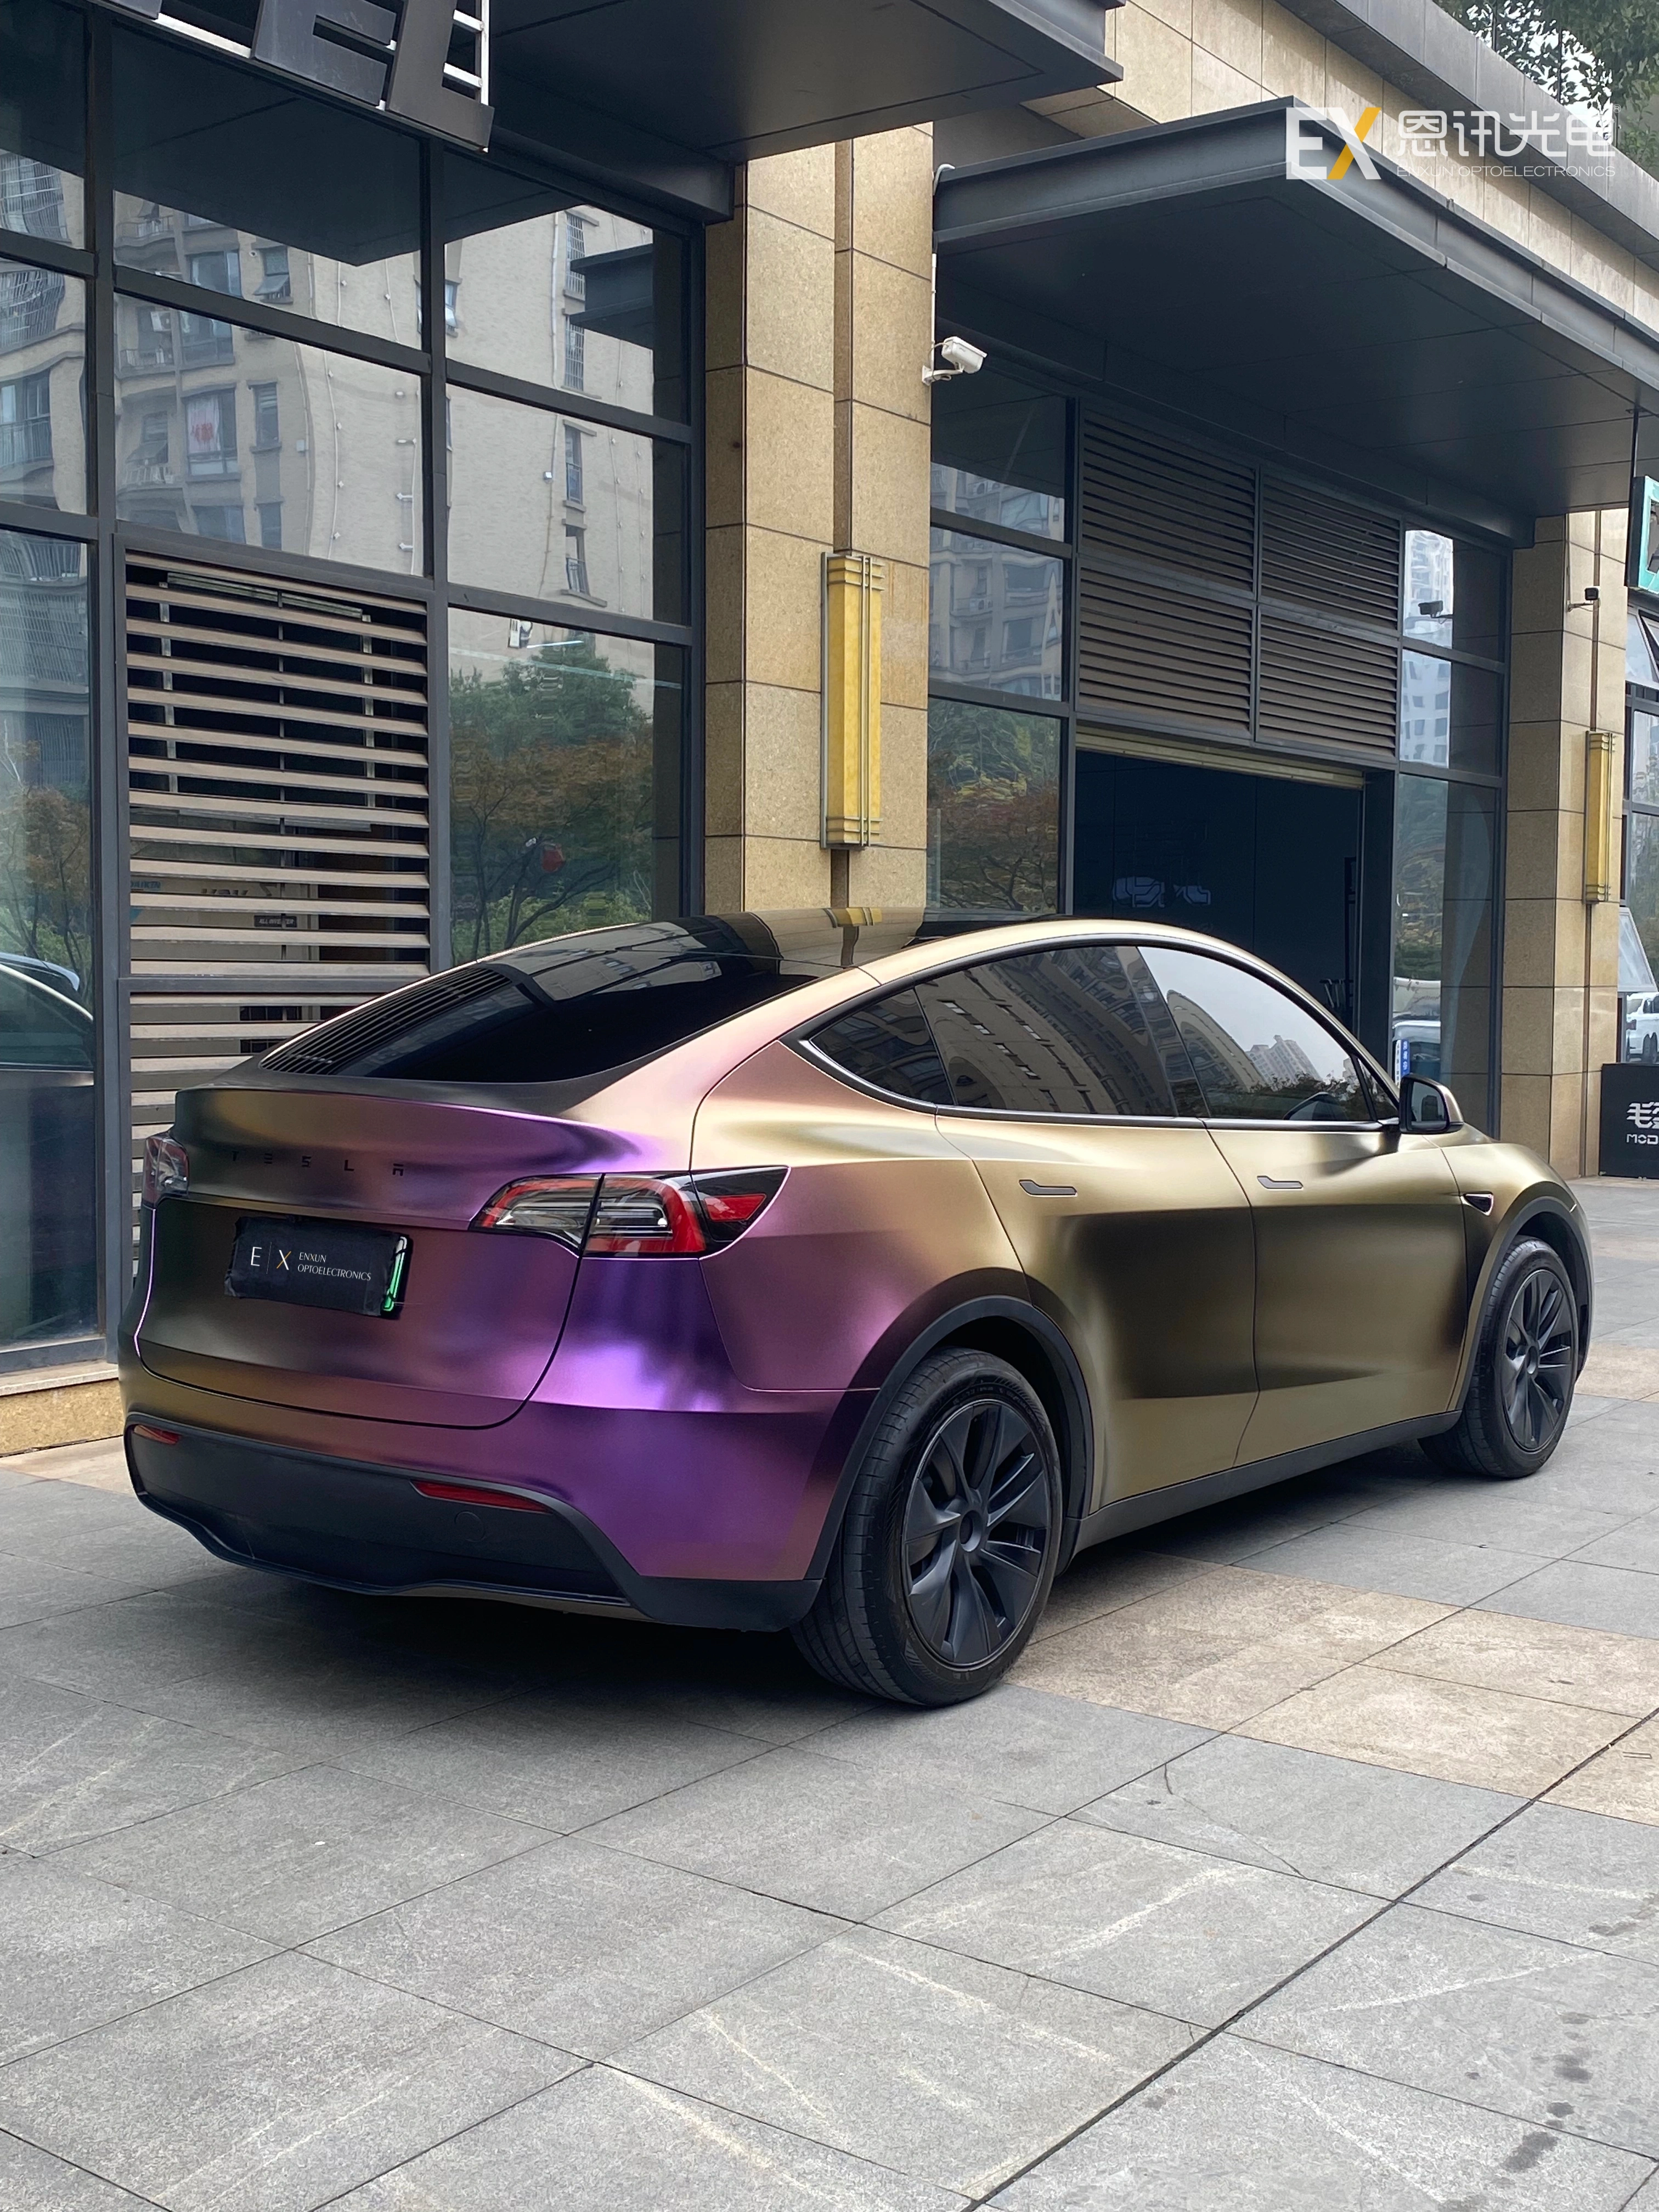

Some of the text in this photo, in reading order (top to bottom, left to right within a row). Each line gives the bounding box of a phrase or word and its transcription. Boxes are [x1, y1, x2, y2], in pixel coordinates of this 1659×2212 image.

[232, 1150, 404, 1176] TESLA
[299, 1252, 326, 1263] ENXUN
[297, 1264, 371, 1281] OPTOELECTRONICS
